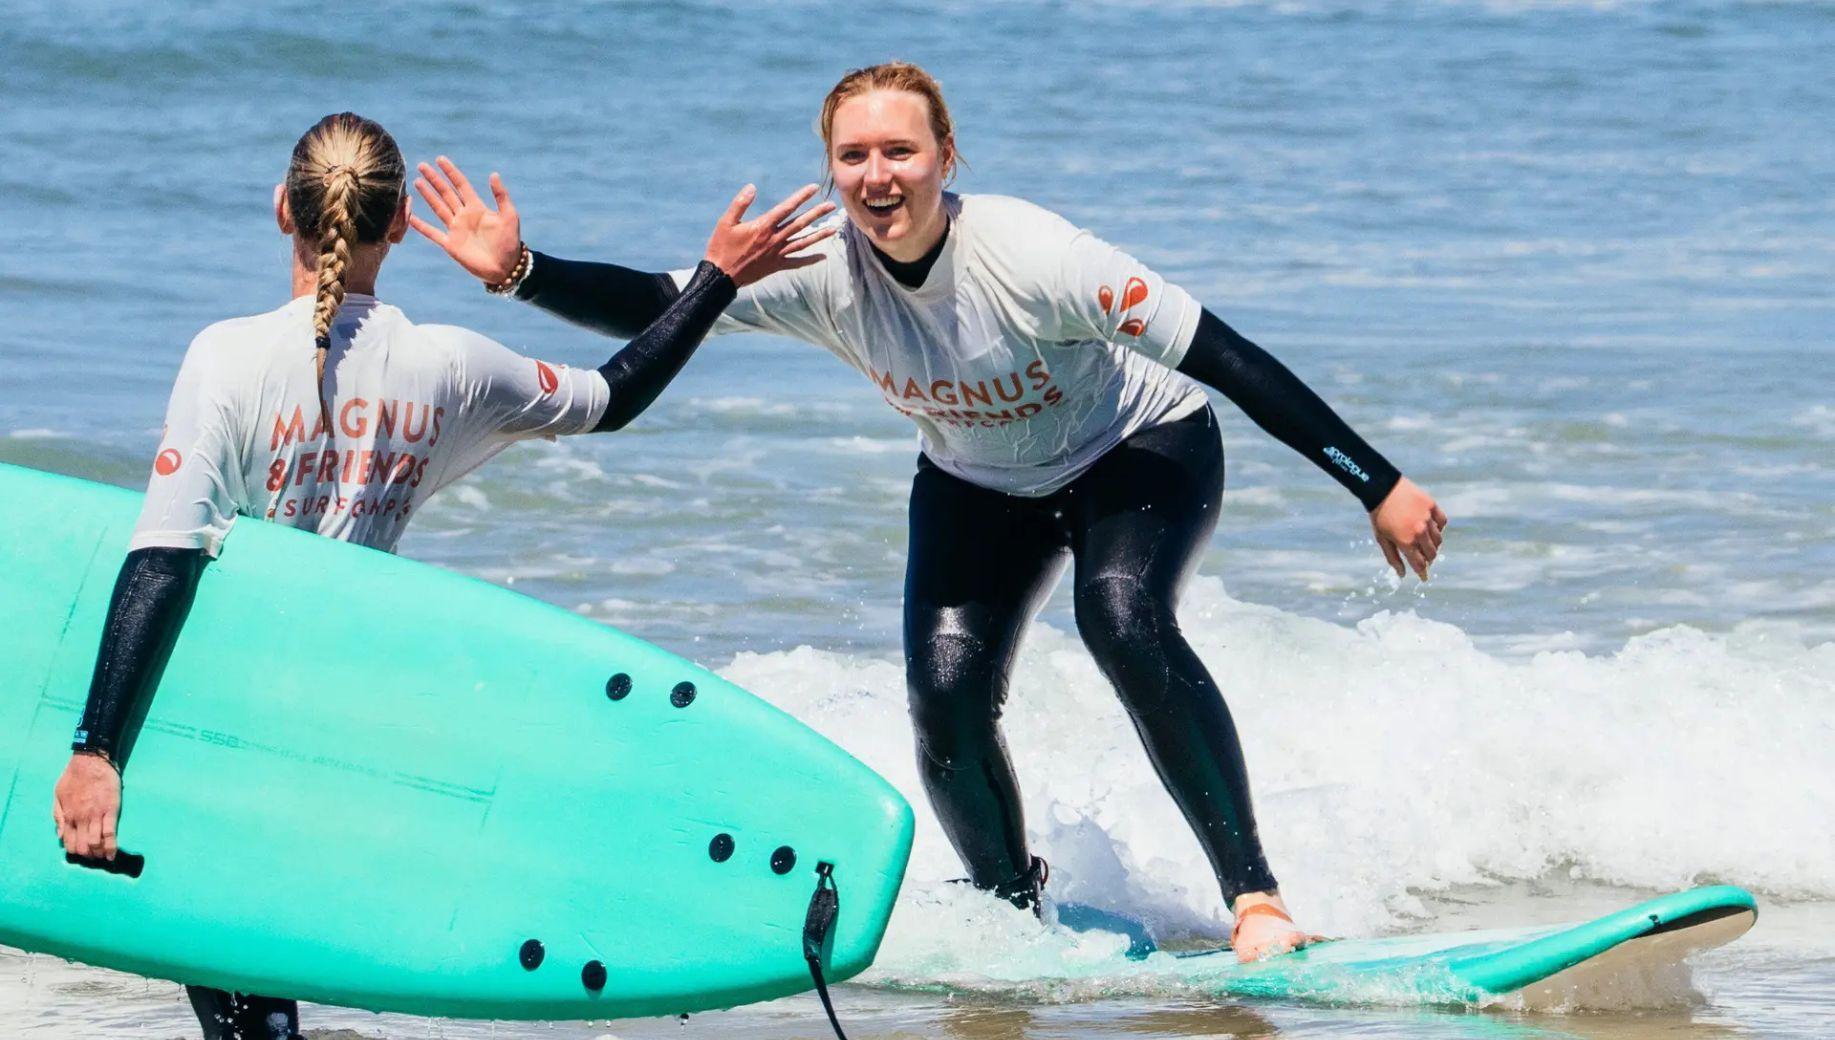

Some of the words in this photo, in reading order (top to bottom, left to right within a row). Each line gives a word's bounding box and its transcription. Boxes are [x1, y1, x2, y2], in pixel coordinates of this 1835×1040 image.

[869, 359, 1050, 407] MAGNUS
[269, 397, 445, 452] MAGNUS
[294, 449, 430, 489] FRIENDS
